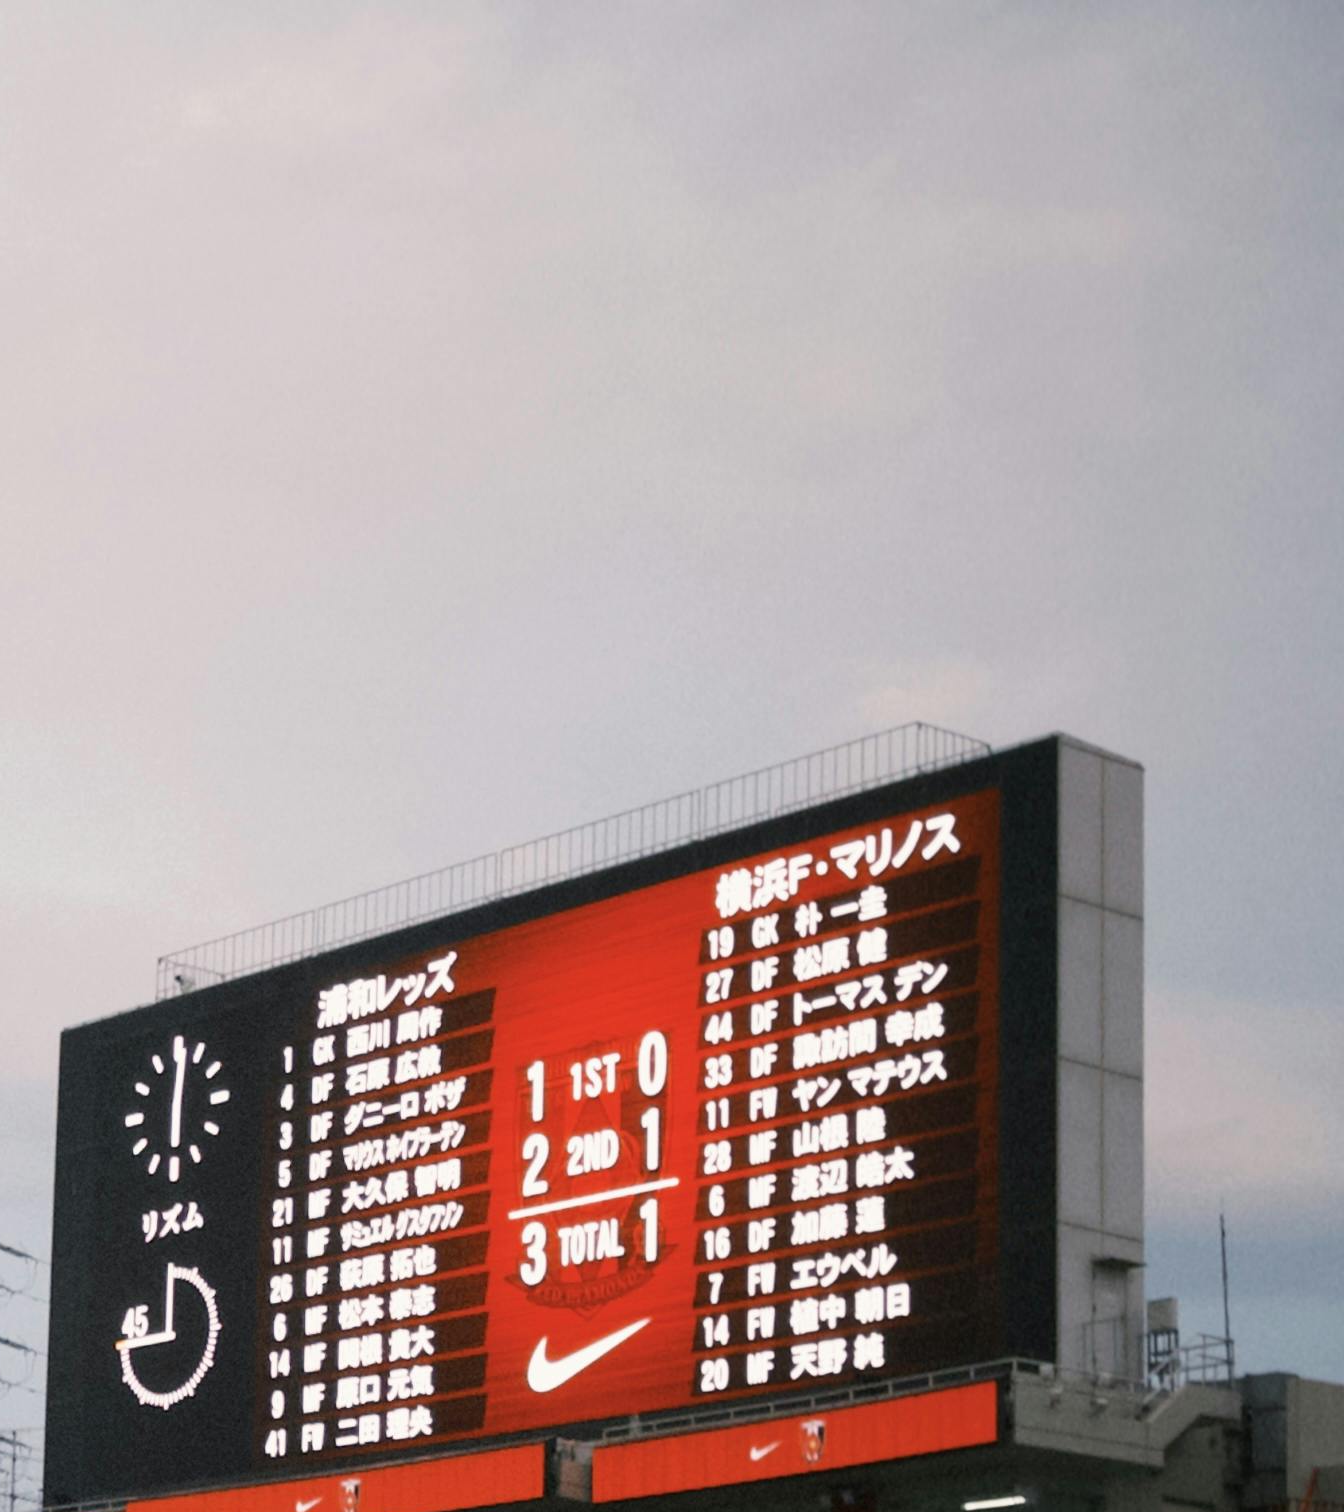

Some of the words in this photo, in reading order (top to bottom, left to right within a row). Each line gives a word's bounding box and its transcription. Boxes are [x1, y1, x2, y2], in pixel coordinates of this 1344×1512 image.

[716, 813, 961, 918] 横浜F・マリノス
[709, 927, 734, 959] 19
[752, 914, 778, 948] GK
[795, 902, 822, 937] 朴
[831, 886, 886, 921] 一圭
[317, 951, 457, 1028] 浦和レッズ
[706, 969, 733, 1002] 27
[752, 957, 778, 991] DF
[793, 938, 849, 981] 松原
[705, 1012, 732, 1044] 44
[751, 1000, 778, 1034] DF
[793, 975, 886, 1025] トーマス
[894, 961, 947, 1001] デン
[283, 1046, 293, 1073] 1
[313, 1035, 334, 1065] GK
[347, 1019, 390, 1057] 西川
[705, 1055, 732, 1088] 33
[751, 1044, 777, 1077] DF
[280, 1084, 293, 1110] 4
[312, 1073, 334, 1103] DF
[346, 1058, 389, 1095] 石原
[527, 1060, 544, 1122] 1
[569, 1052, 621, 1101] 1ST
[638, 1030, 667, 1096] 0
[706, 1099, 728, 1130] 11
[750, 1088, 777, 1121] FW
[792, 1077, 841, 1111] ヤン
[848, 1051, 946, 1096] マテウス
[280, 1122, 292, 1149] 3
[311, 1112, 333, 1142] DF
[344, 1092, 419, 1134] ダニーロ
[424, 1077, 466, 1114] ボザ
[278, 1160, 291, 1187] 5
[309, 1151, 332, 1180] DF
[522, 1133, 549, 1197] 2
[566, 1129, 620, 1176] 2ND
[641, 1107, 660, 1171] 1
[704, 1141, 731, 1174] 28
[750, 1131, 777, 1164] MF
[793, 1114, 848, 1156] 山根
[273, 1198, 293, 1227] 21
[309, 1189, 330, 1218] MF
[342, 1171, 408, 1213] 大久保
[709, 1186, 724, 1216] 6
[749, 1175, 776, 1208] MF
[792, 1160, 848, 1201] 渡辺
[142, 1202, 204, 1243] リズム
[273, 1236, 292, 1264] 11
[307, 1228, 329, 1257] MF
[520, 1221, 547, 1286] 3
[557, 1218, 625, 1267] TOTAL
[639, 1198, 658, 1262] 1
[704, 1228, 730, 1259] 16
[749, 1219, 775, 1252] DF
[791, 1204, 847, 1244] 加藤
[270, 1274, 293, 1303] 26
[306, 1267, 328, 1296] DF
[390, 1245, 436, 1281] 拓也
[709, 1273, 723, 1303] 7
[748, 1263, 775, 1296] FW
[121, 1304, 148, 1339] 45
[273, 1313, 286, 1341] 6
[305, 1306, 327, 1335] MF
[339, 1294, 384, 1329] 松本
[703, 1315, 729, 1347] 14
[748, 1307, 775, 1340] FW
[855, 1284, 909, 1323] 朝日
[270, 1350, 290, 1378] 14
[304, 1343, 326, 1372] MF
[701, 1359, 728, 1391] 20
[747, 1351, 774, 1384] MF
[791, 1339, 847, 1379] 天野
[271, 1390, 284, 1418] 9
[303, 1384, 325, 1413] MF
[336, 1375, 380, 1408] 原口
[265, 1429, 286, 1457] 41
[302, 1423, 324, 1452] FW
